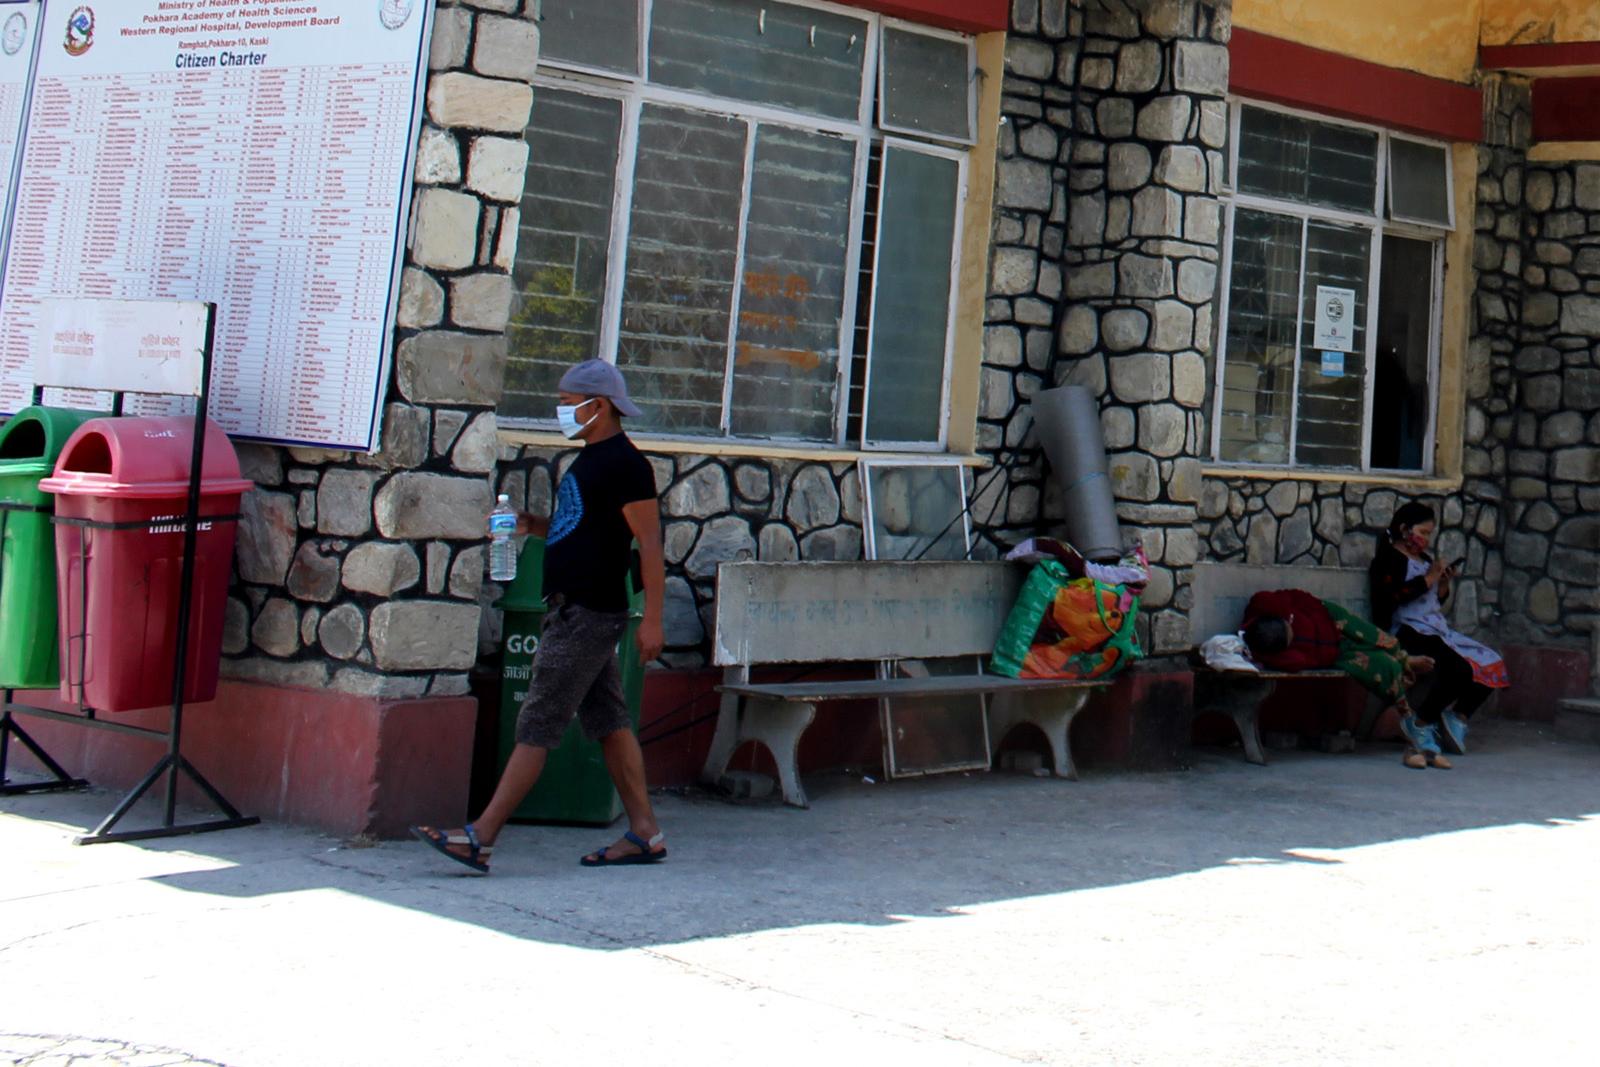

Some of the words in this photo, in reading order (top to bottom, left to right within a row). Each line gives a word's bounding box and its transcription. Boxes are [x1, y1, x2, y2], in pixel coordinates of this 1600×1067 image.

[142, 12, 179, 24] Pokhara
[181, 10, 225, 24] Academy
[226, 9, 237, 20] of
[238, 7, 270, 18] Health
[272, 5, 318, 16] Sciences
[158, 0, 195, 12] Ministry
[197, 0, 207, 9] of
[120, 26, 156, 37] Western
[158, 24, 198, 36] Regional
[200, 21, 242, 34] Hospital,
[244, 18, 307, 32] Development
[310, 15, 340, 27] Board
[249, 36, 269, 47] Kaski
[175, 52, 216, 69] Citizen
[219, 51, 267, 67] Charter
[506, 634, 539, 654] GO
